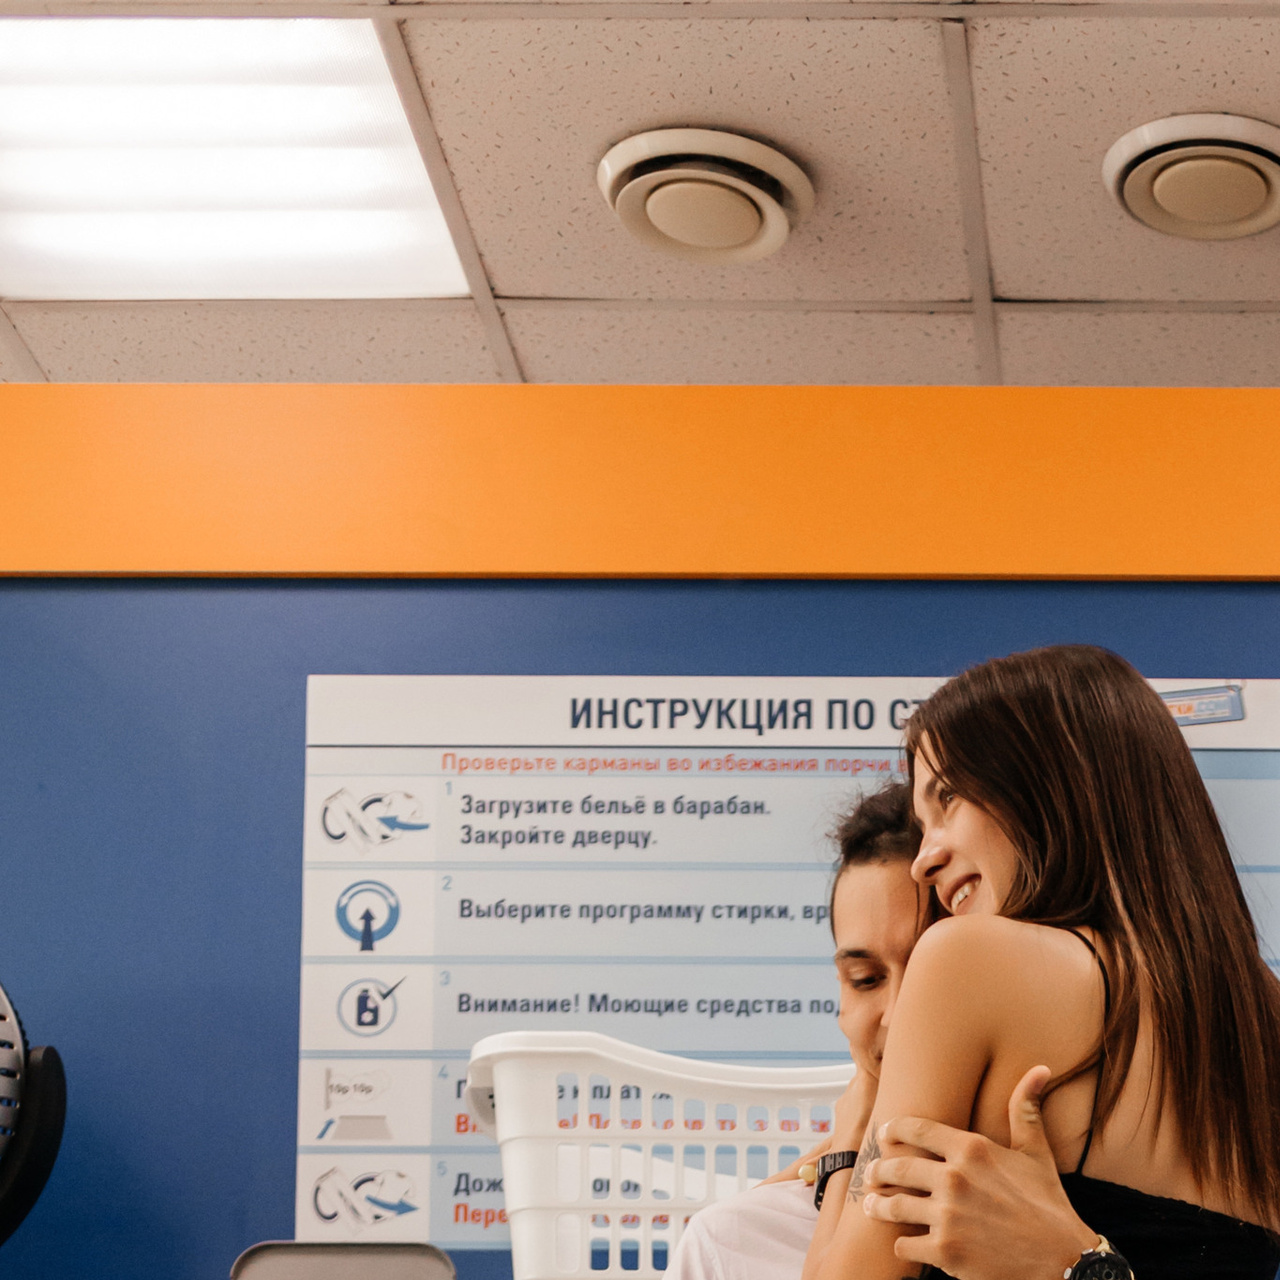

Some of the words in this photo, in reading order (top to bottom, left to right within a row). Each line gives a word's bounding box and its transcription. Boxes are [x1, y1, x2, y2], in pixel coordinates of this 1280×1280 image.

[570, 698, 812, 735] ИНСТРУКЦИЯ
[827, 698, 875, 730] ПО
[889, 698, 925, 730] С
[441, 753, 557, 775] Проверьте
[563, 757, 661, 775] карманы
[667, 758, 692, 771] во
[698, 754, 818, 771] избежания
[825, 758, 890, 775] порчи
[445, 781, 453, 795] 1
[460, 795, 572, 819] Загрузите
[581, 795, 646, 814] бельё
[653, 800, 665, 814] в
[673, 795, 771, 819] барабан.
[460, 824, 565, 849] Закройте
[572, 829, 658, 849] дверцу.
[442, 875, 453, 891] 2
[459, 898, 572, 924] Выберите
[578, 904, 704, 924] программу
[711, 904, 795, 924] стирки,
[439, 971, 451, 986] 3
[458, 993, 580, 1013] Внимание!
[588, 993, 688, 1016] Моющие
[696, 999, 802, 1018] средства
[437, 1161, 448, 1176] 5
